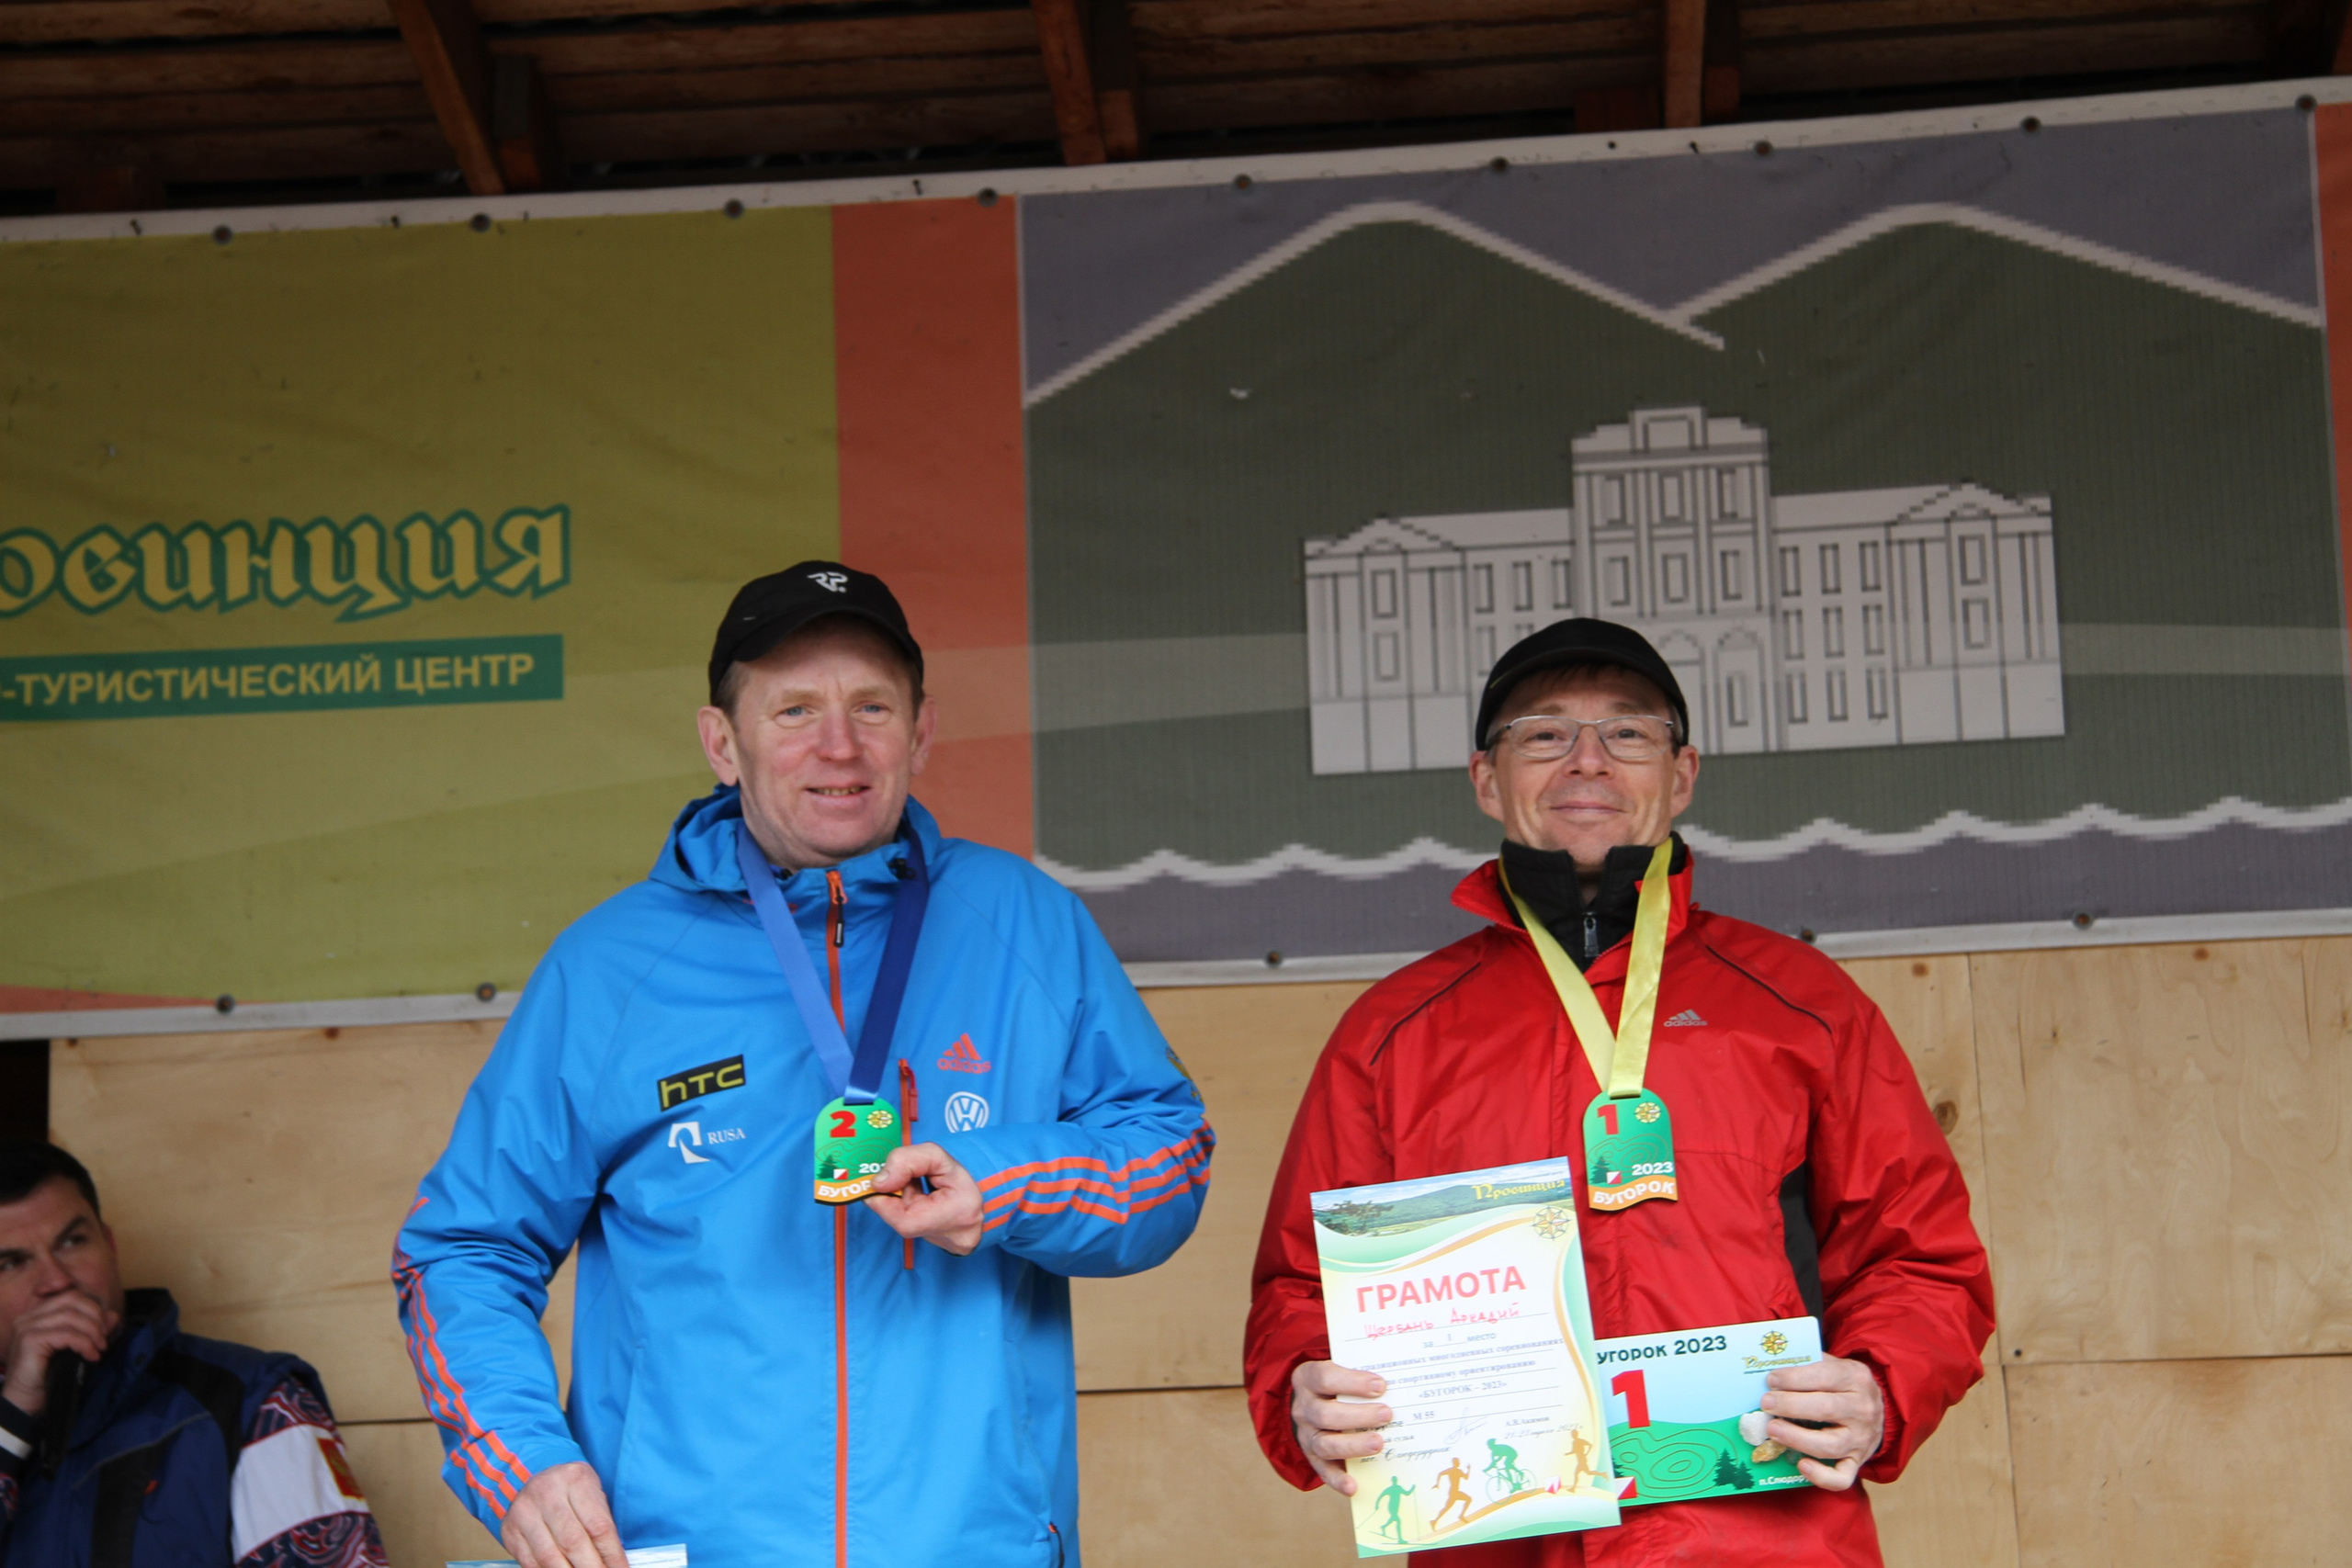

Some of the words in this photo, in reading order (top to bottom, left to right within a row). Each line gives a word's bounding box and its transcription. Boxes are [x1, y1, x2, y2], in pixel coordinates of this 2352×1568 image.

[394, 653, 534, 694] ЦЕНТР
[1664, 1019, 1708, 1027] adidas
[937, 1056, 991, 1075] adidas
[830, 1111, 856, 1138] 2
[1597, 1104, 1619, 1135] 1
[858, 1162, 886, 1174] 20
[1632, 1161, 1674, 1176] 2023
[818, 1179, 872, 1198] БУГОР
[1592, 1180, 1676, 1205] БУГОРОК
[1356, 1266, 1526, 1313] ГРАМОТА
[1421, 1340, 1434, 1348] за
[1466, 1332, 1497, 1342] место
[1597, 1344, 1668, 1364] УГОРОК
[1674, 1336, 1727, 1355] 2023
[1611, 1370, 1650, 1428] 1
